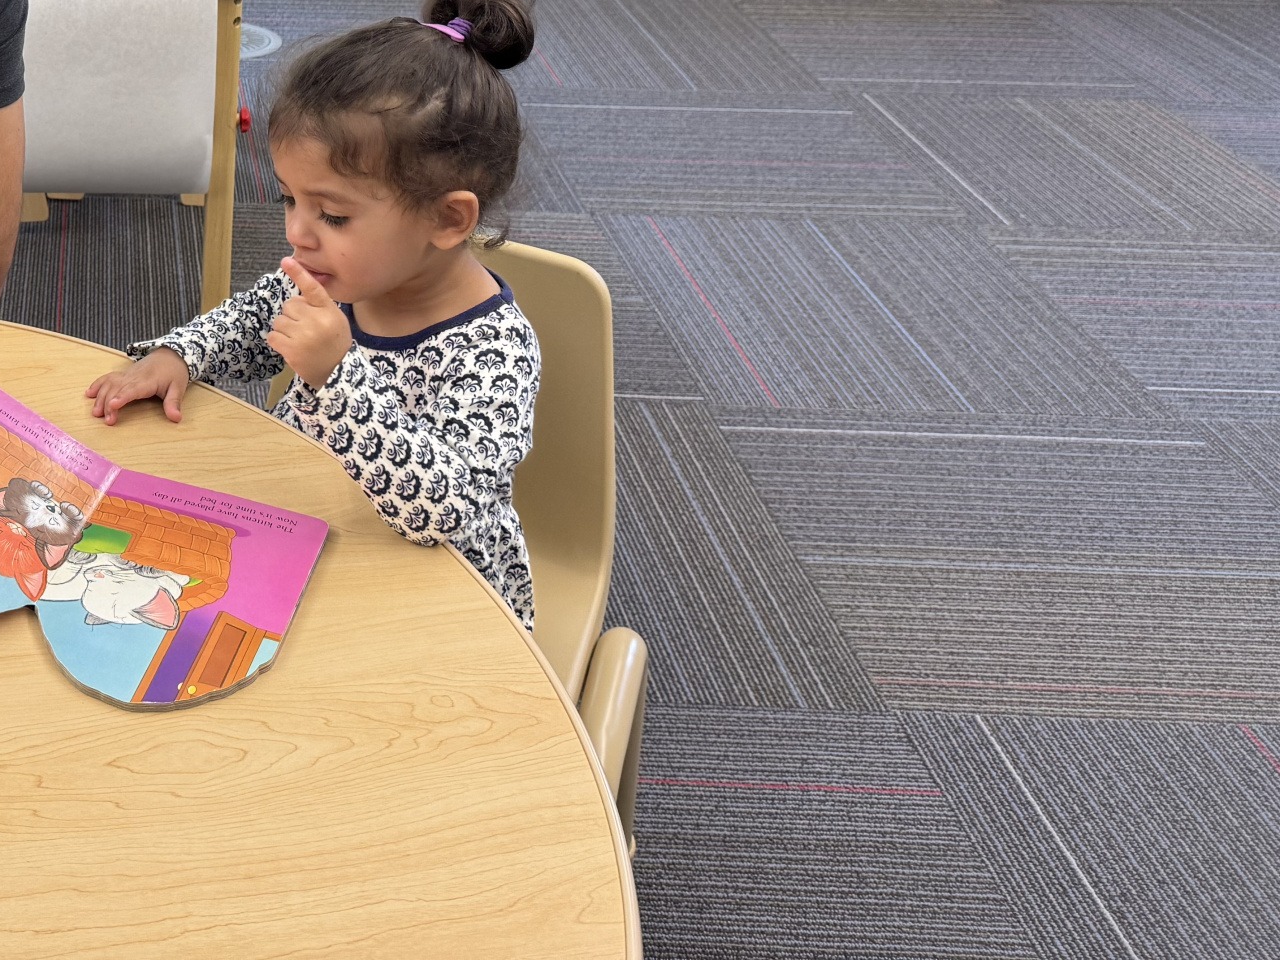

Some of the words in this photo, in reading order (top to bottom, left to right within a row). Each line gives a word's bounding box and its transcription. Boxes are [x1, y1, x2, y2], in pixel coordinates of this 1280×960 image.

[21, 424, 40, 439] little
[153, 491, 169, 500] day
[200, 496, 217, 505] bed
[183, 500, 215, 512] played
[220, 501, 233, 510] for
[236, 505, 257, 515] time
[217, 508, 239, 519] have
[259, 511, 273, 520] it's
[241, 515, 273, 528] kittens
[275, 516, 298, 527] Now
[276, 524, 295, 534] The
